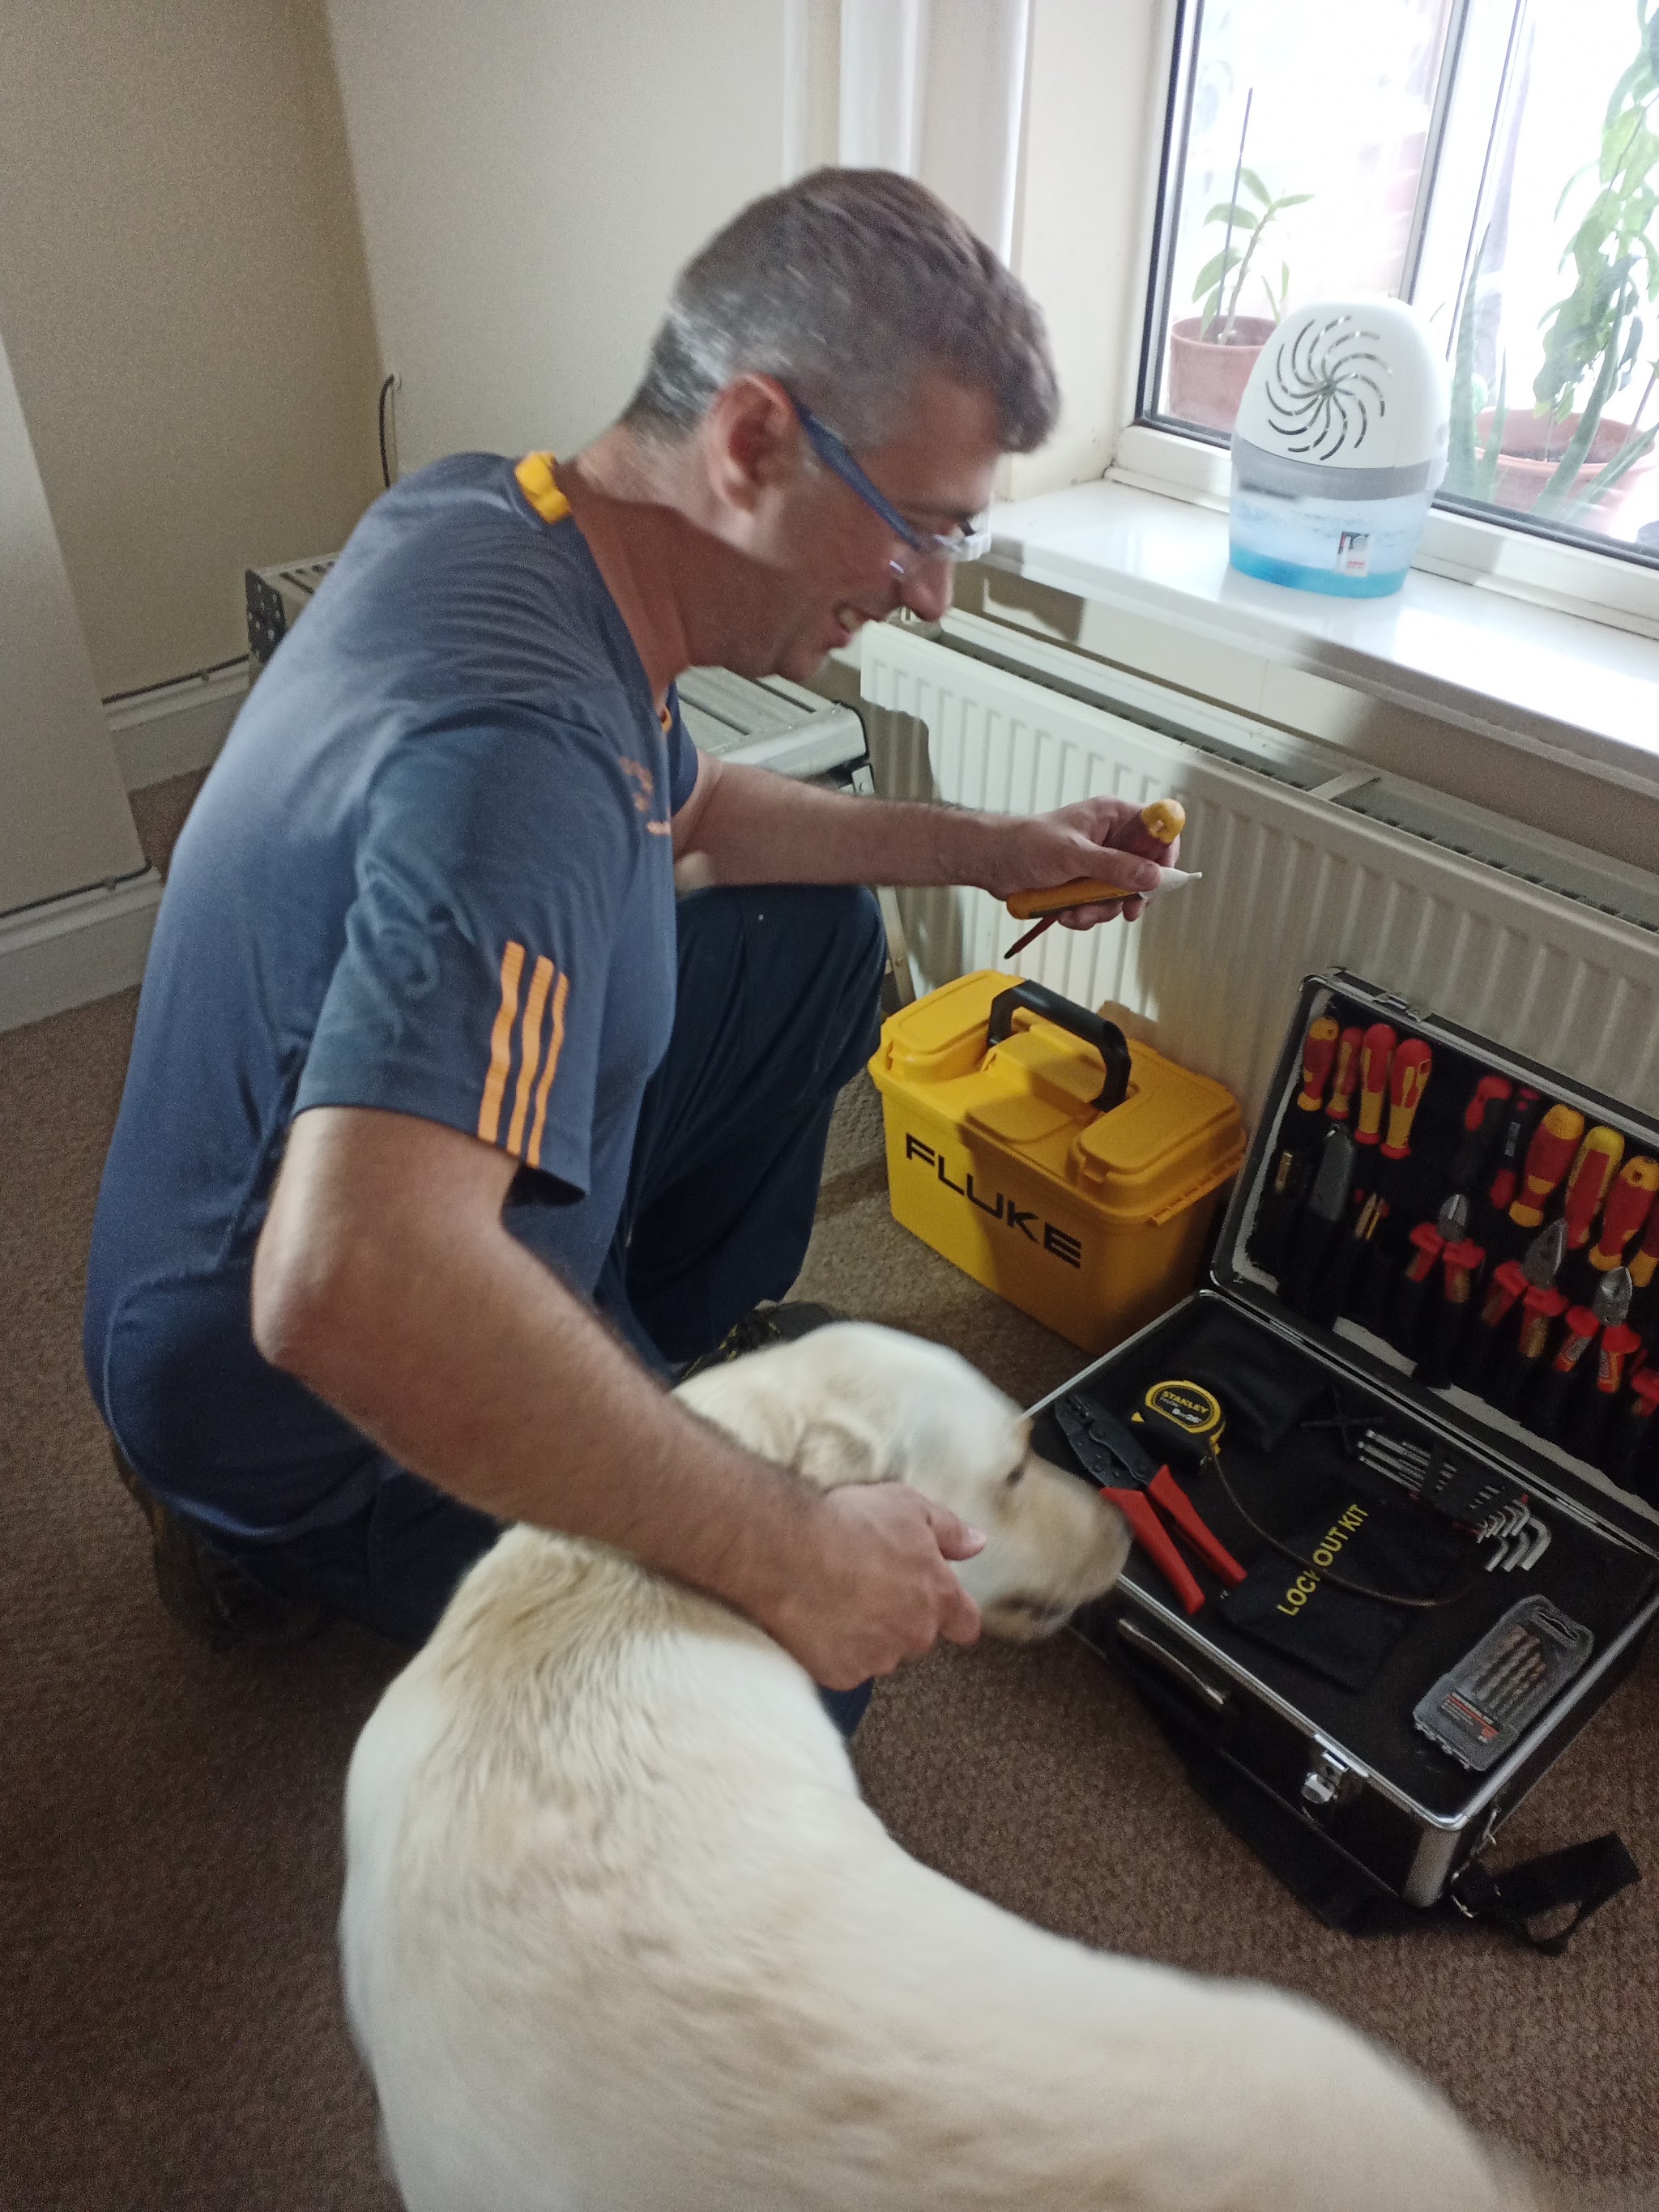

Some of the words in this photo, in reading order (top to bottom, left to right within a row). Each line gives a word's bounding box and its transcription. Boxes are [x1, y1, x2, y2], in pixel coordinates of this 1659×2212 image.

[906, 1132, 1082, 1268] FLUKE
[1162, 1391, 1209, 1414] STANLEY
[1312, 1526, 1349, 1566] OUT
[1338, 1503, 1369, 1532] KIT
